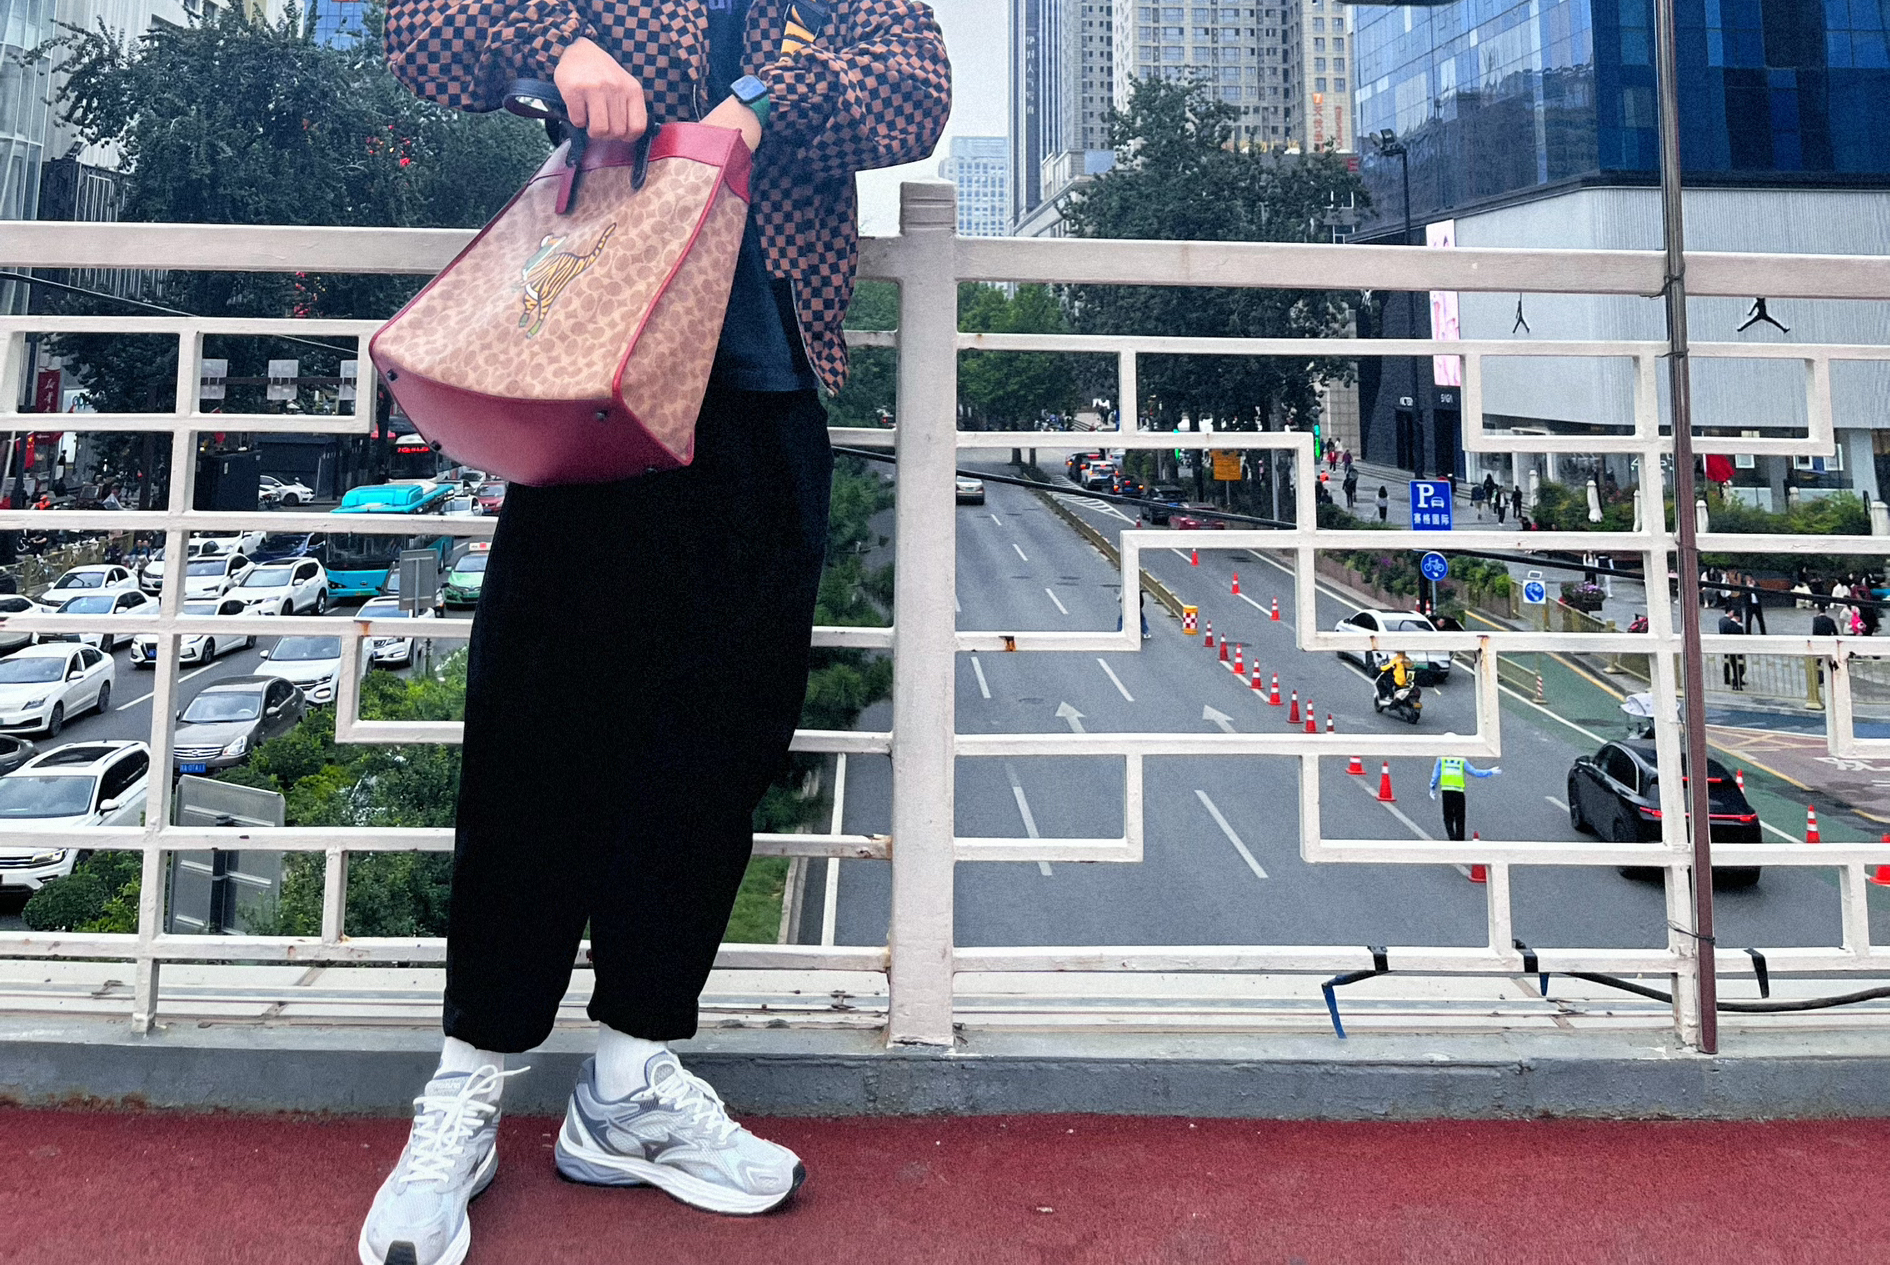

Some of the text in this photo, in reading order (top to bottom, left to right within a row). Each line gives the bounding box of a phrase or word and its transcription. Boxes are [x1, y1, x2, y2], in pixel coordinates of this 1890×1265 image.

[1416, 483, 1435, 508] P
[1413, 512, 1450, 526] 赛格国际
